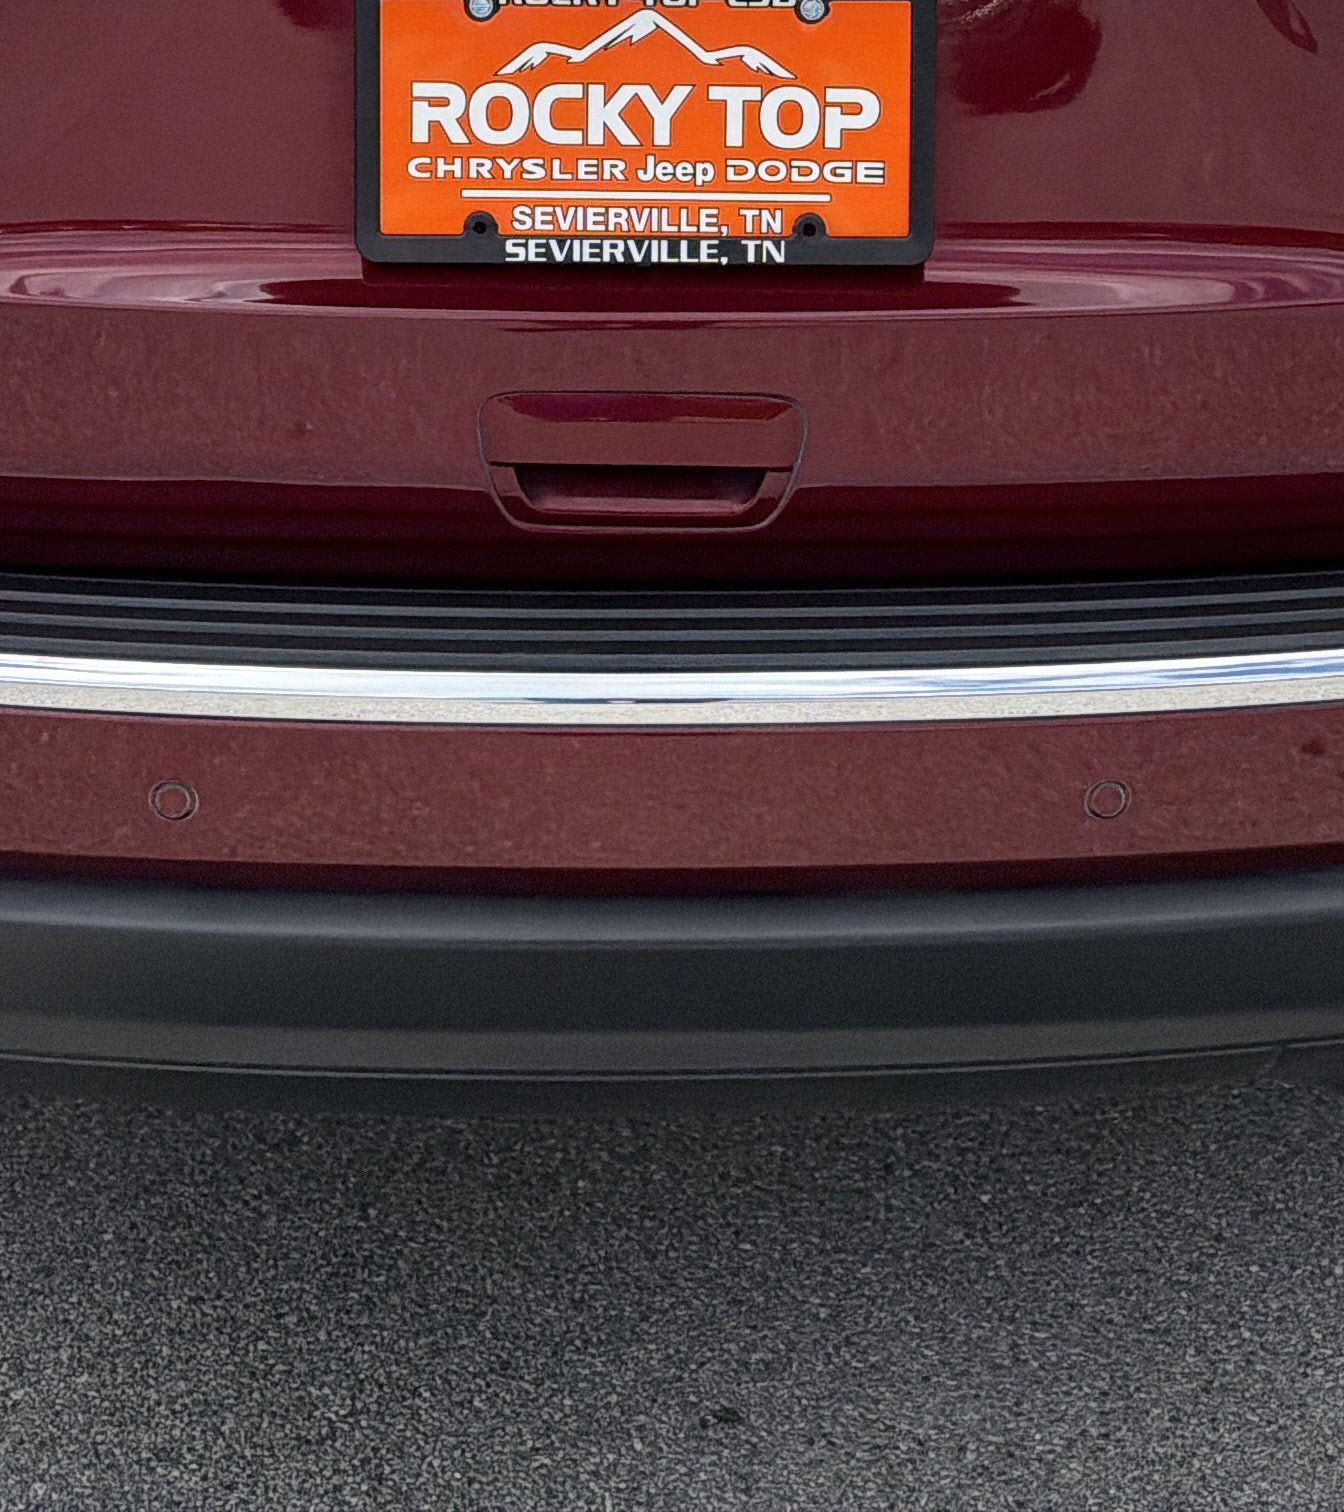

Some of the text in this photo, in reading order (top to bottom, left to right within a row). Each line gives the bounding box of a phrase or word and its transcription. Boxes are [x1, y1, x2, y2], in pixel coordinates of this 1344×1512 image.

[411, 81, 881, 150] ROCKY TOP
[408, 155, 885, 187] CHRYSLER Jeep DODGE
[512, 205, 782, 237] SEVIERVILLE, TN
[505, 238, 786, 266] SEVIERVILLE, TN
